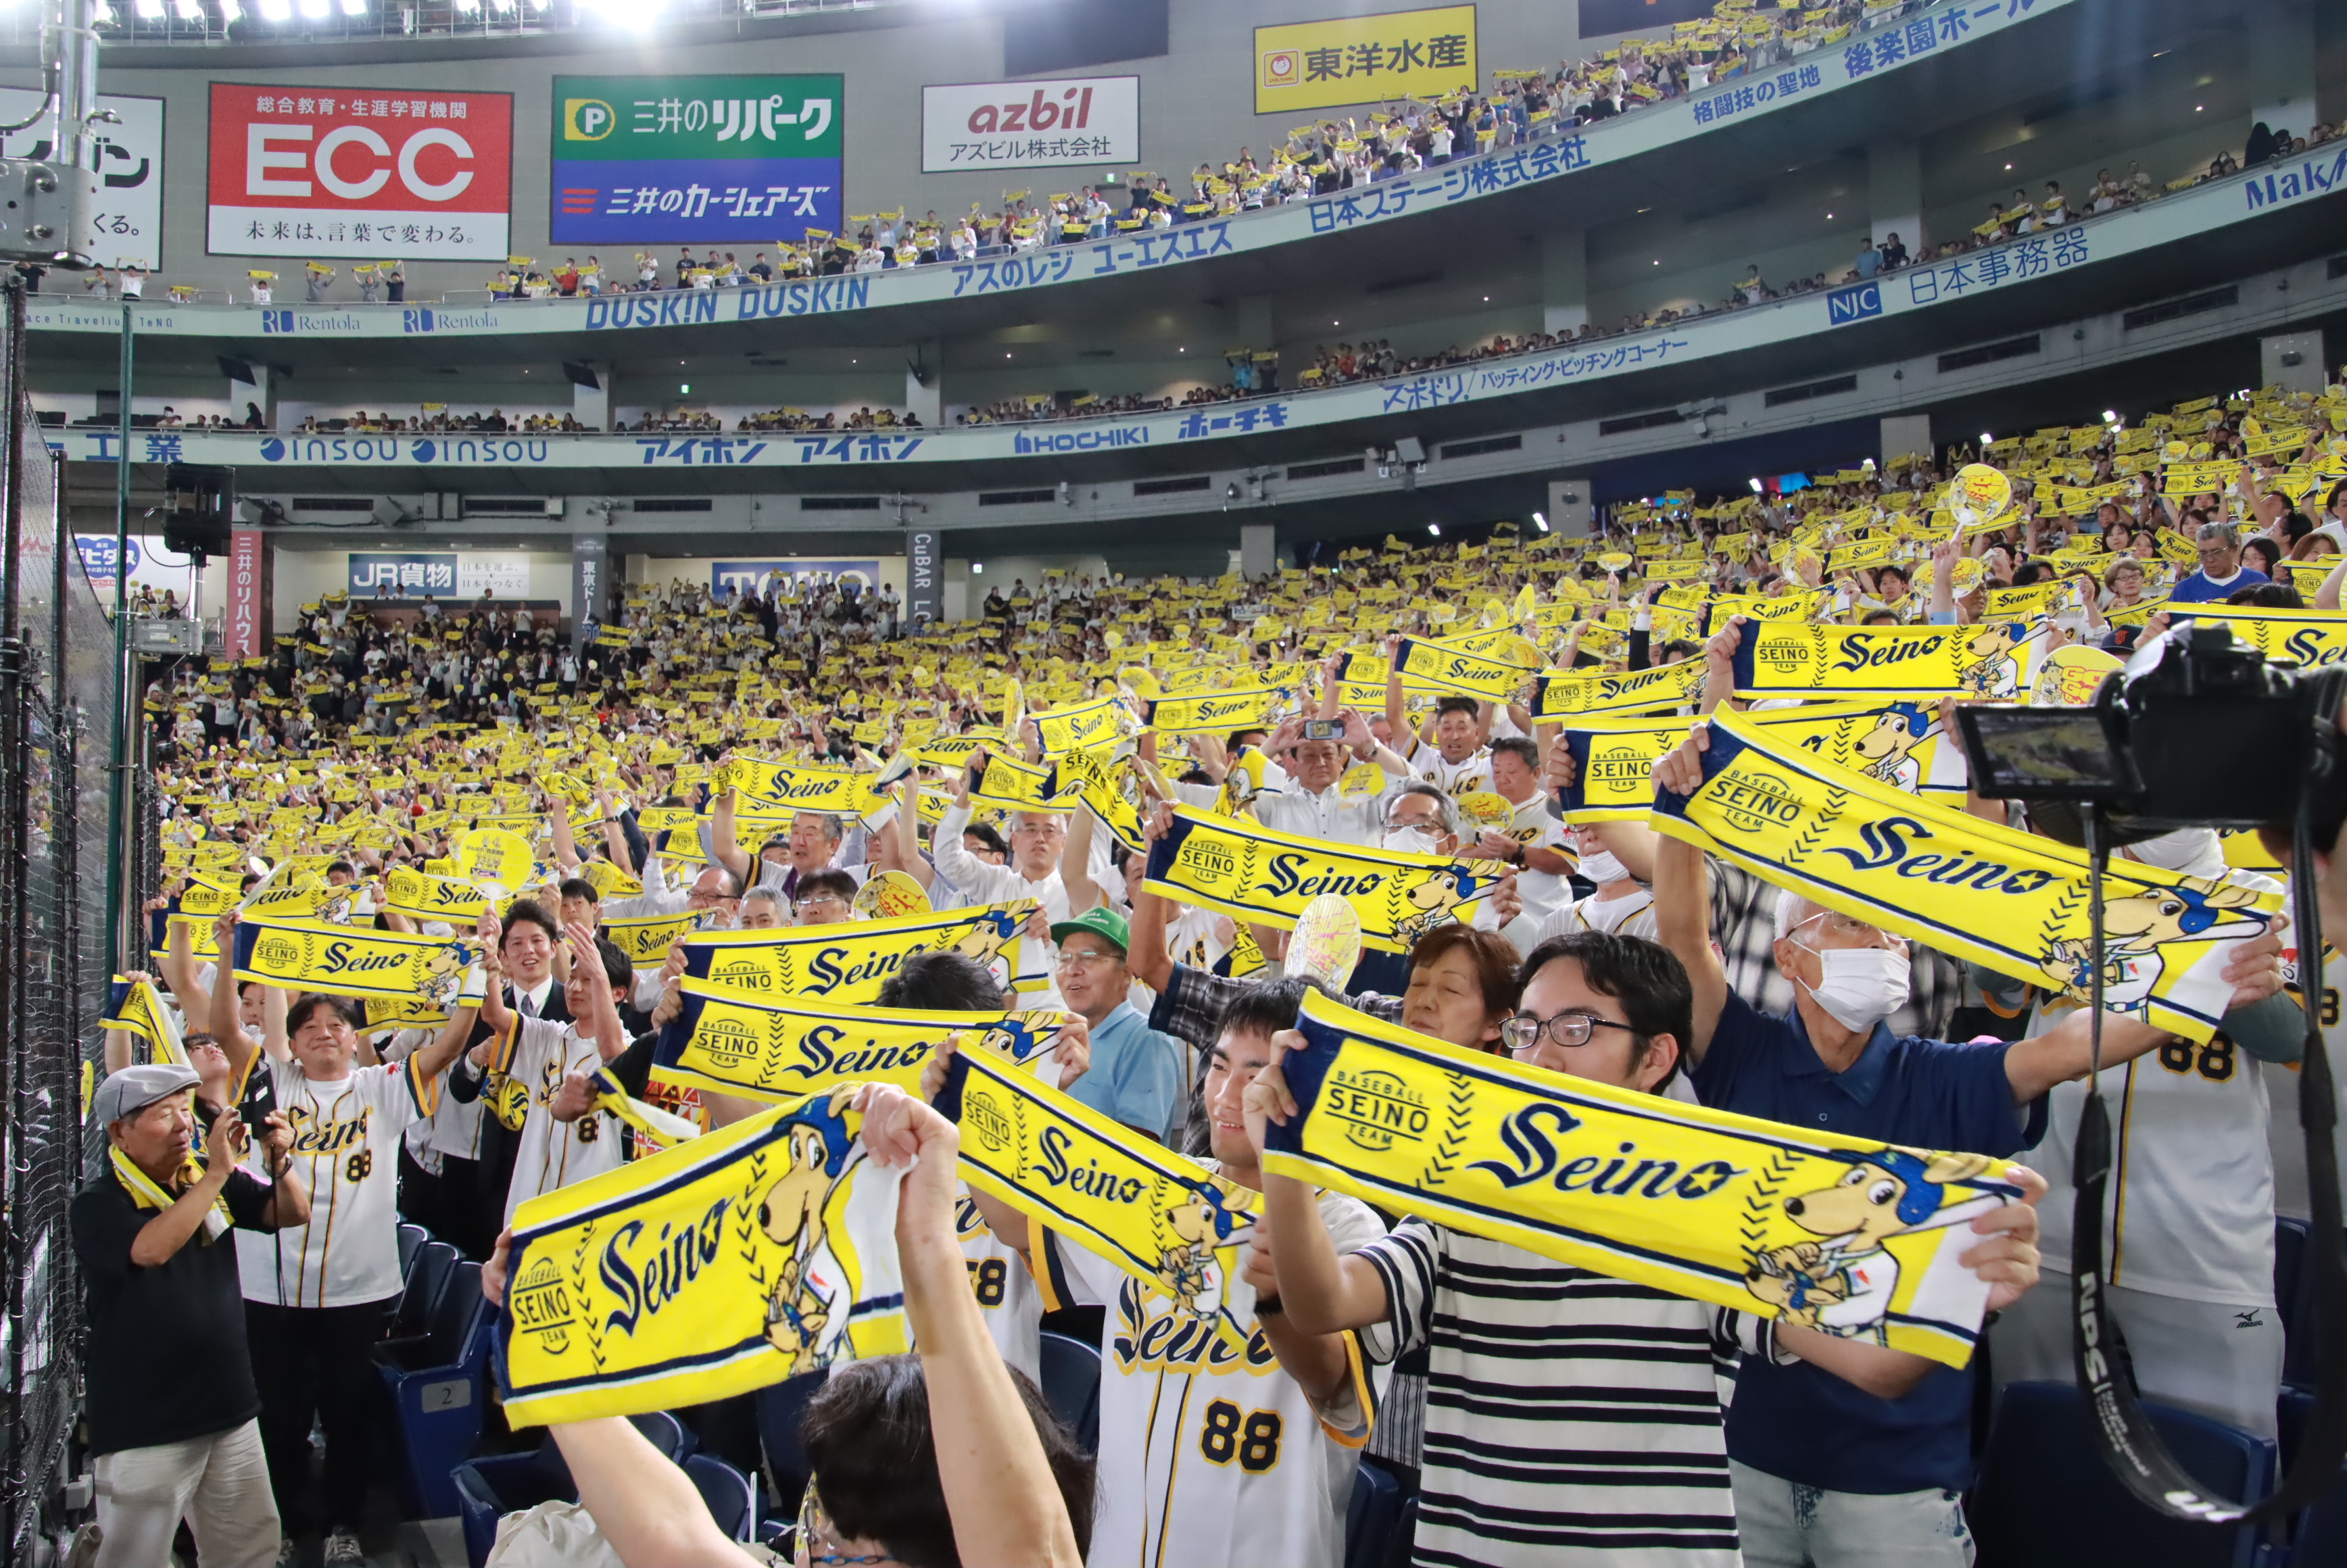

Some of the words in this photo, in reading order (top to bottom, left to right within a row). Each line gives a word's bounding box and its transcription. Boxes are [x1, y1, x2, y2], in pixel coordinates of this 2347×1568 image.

[1305, 34, 1467, 82] 東洋水産
[1693, 64, 1820, 126] 格闘技の聖地
[256, 96, 468, 120] 総合教育・生涯学習機関
[585, 107, 606, 133] P
[633, 94, 832, 141] 三井のリパーク
[968, 87, 1093, 134] azbil
[950, 136, 1112, 161] アズビル株式会社
[246, 123, 475, 201] ECC
[1309, 135, 1591, 234] 日本ステージ株式会社
[606, 183, 830, 218] 三井のカーシェアーズ
[245, 221, 475, 243] 未来は、言葉で変わる。
[951, 251, 1073, 297] アスのレジ
[1094, 222, 1233, 275] ユーエスエス
[1910, 226, 2089, 305] 日本事務器
[1832, 287, 1878, 319] NJC
[59, 314, 122, 326] Traveliu
[299, 315, 360, 331] Rentola
[439, 312, 498, 329] Rentola
[1481, 339, 1688, 390] バッティング・ピッチングコーナー
[1179, 404, 1288, 438] ホーチキ
[636, 438, 767, 464] アイホン
[794, 435, 923, 463] アイホン
[1034, 426, 1148, 453] HOCHIKI
[2269, 433, 2298, 447] Seino
[1852, 544, 1881, 559] Seino
[2166, 536, 2192, 556] Seino
[915, 533, 932, 589] CuBAR
[354, 562, 452, 589] JR貨物
[237, 537, 253, 657] 三井のリハウス
[1409, 656, 1434, 666] SEINO
[1760, 647, 1810, 661] SEINO
[1831, 633, 1948, 673] Seino
[1259, 666, 1294, 685] Seino
[1444, 658, 1504, 680] Seino
[1348, 687, 1386, 701] Sein
[1547, 688, 1580, 699] SEINO
[1157, 710, 1182, 719] SEINO
[1194, 700, 1252, 721] Seino
[1070, 714, 1103, 739] Seino
[1593, 752, 1648, 762] BASEBALL
[986, 774, 1015, 786] SEINO
[1593, 761, 1652, 779] SEINO
[763, 769, 843, 800] Seino
[1610, 780, 1636, 788] TEAM
[1730, 768, 1804, 805] BASEBALL
[1710, 781, 1801, 823] SEINO
[663, 813, 696, 826] Seino
[1725, 808, 1763, 829] TEAM
[1182, 849, 1234, 874] SEINO
[1186, 841, 1233, 858] BASEBALL
[1823, 817, 2065, 895] Seino
[1194, 869, 1219, 883] TEAM
[1255, 853, 1386, 897] Seino
[185, 892, 218, 901] SEINO
[233, 887, 308, 906] eino
[387, 885, 418, 896] SEINO
[259, 938, 297, 948] BASEBALL
[637, 922, 675, 954] Seino
[257, 946, 299, 960] SEINO
[316, 942, 408, 975] Seino
[715, 964, 767, 975] BASEBALL
[704, 1021, 756, 1037] BASEBALL
[698, 1032, 758, 1056] SEINO
[783, 1025, 935, 1078] Seino
[2158, 1032, 2237, 1081] 88
[710, 1054, 740, 1067] TEAM
[1336, 1069, 1424, 1103] BASEBALL
[965, 1089, 1008, 1125] BASEBALL
[1329, 1087, 1430, 1134] SEINO
[965, 1102, 1011, 1142] SEINO
[1349, 1123, 1393, 1145] TEAM
[978, 1130, 1002, 1151] TEAM
[1466, 1102, 1747, 1200] Seino
[345, 1148, 372, 1183] 88
[1032, 1125, 1148, 1204] Seino
[516, 1266, 562, 1290] BASEBALL
[599, 1195, 737, 1338] Seino
[514, 1288, 570, 1325] SEINO
[541, 1328, 568, 1346] TEAM
[440, 1386, 452, 1404] 2
[1199, 1396, 1284, 1475] 88
